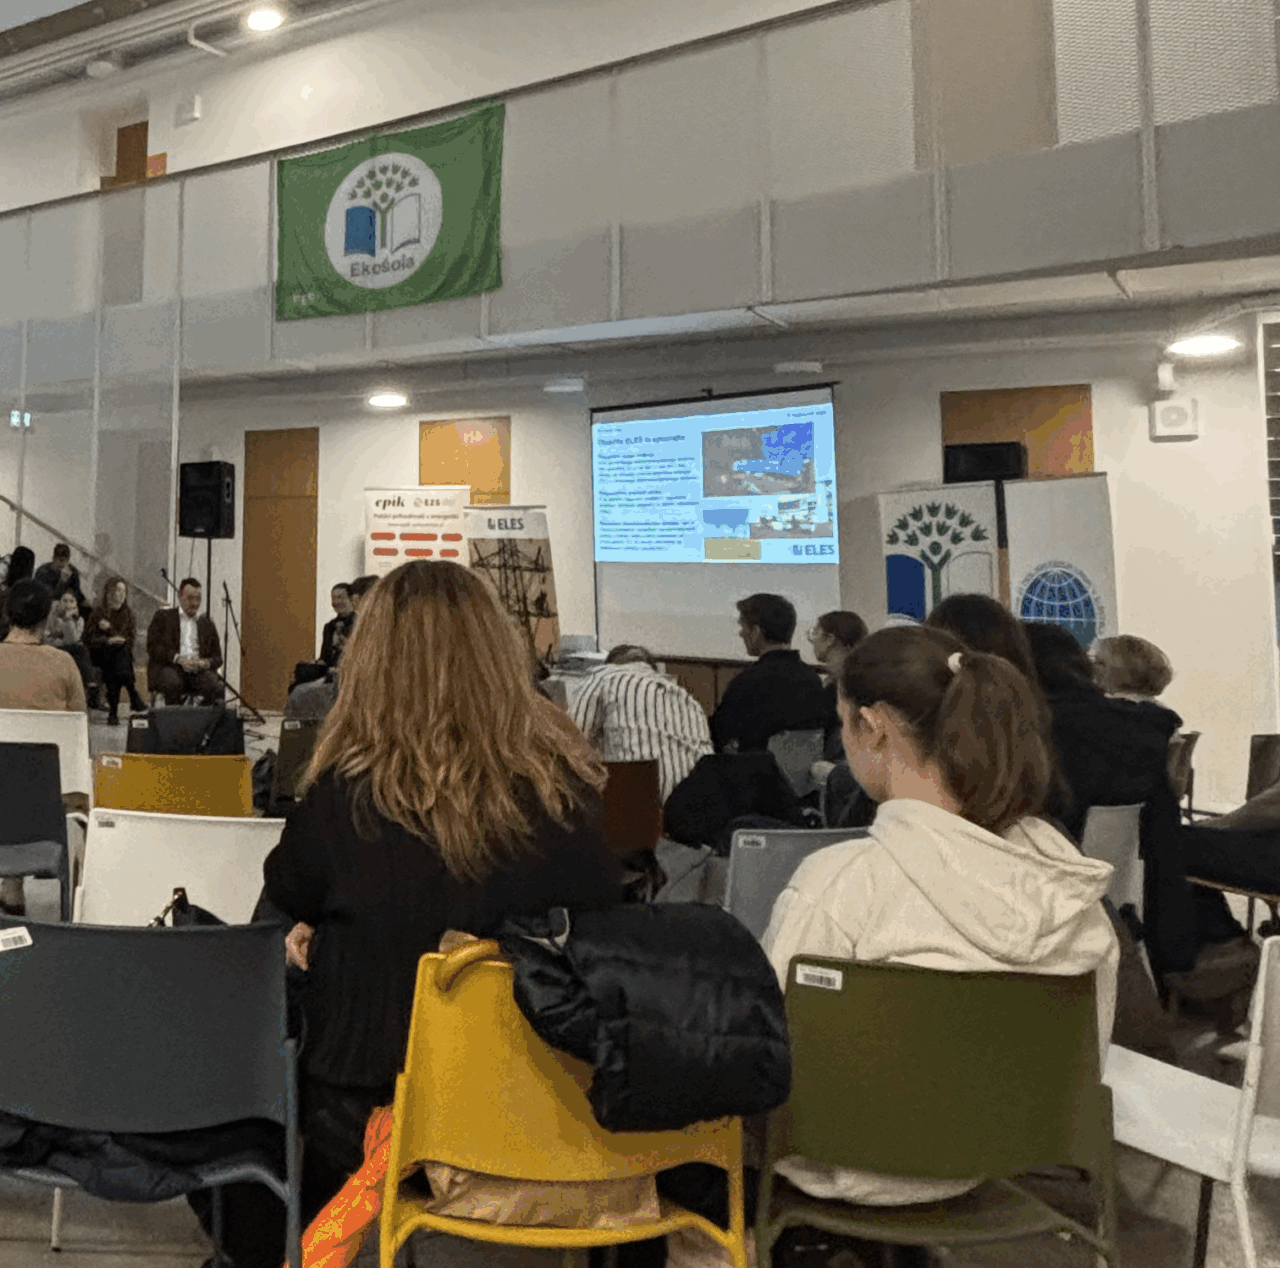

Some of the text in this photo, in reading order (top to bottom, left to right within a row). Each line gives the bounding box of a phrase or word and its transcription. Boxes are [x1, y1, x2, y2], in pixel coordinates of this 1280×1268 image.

[375, 495, 405, 511] epik
[497, 517, 525, 530] ELES
[805, 543, 835, 556] ELES
